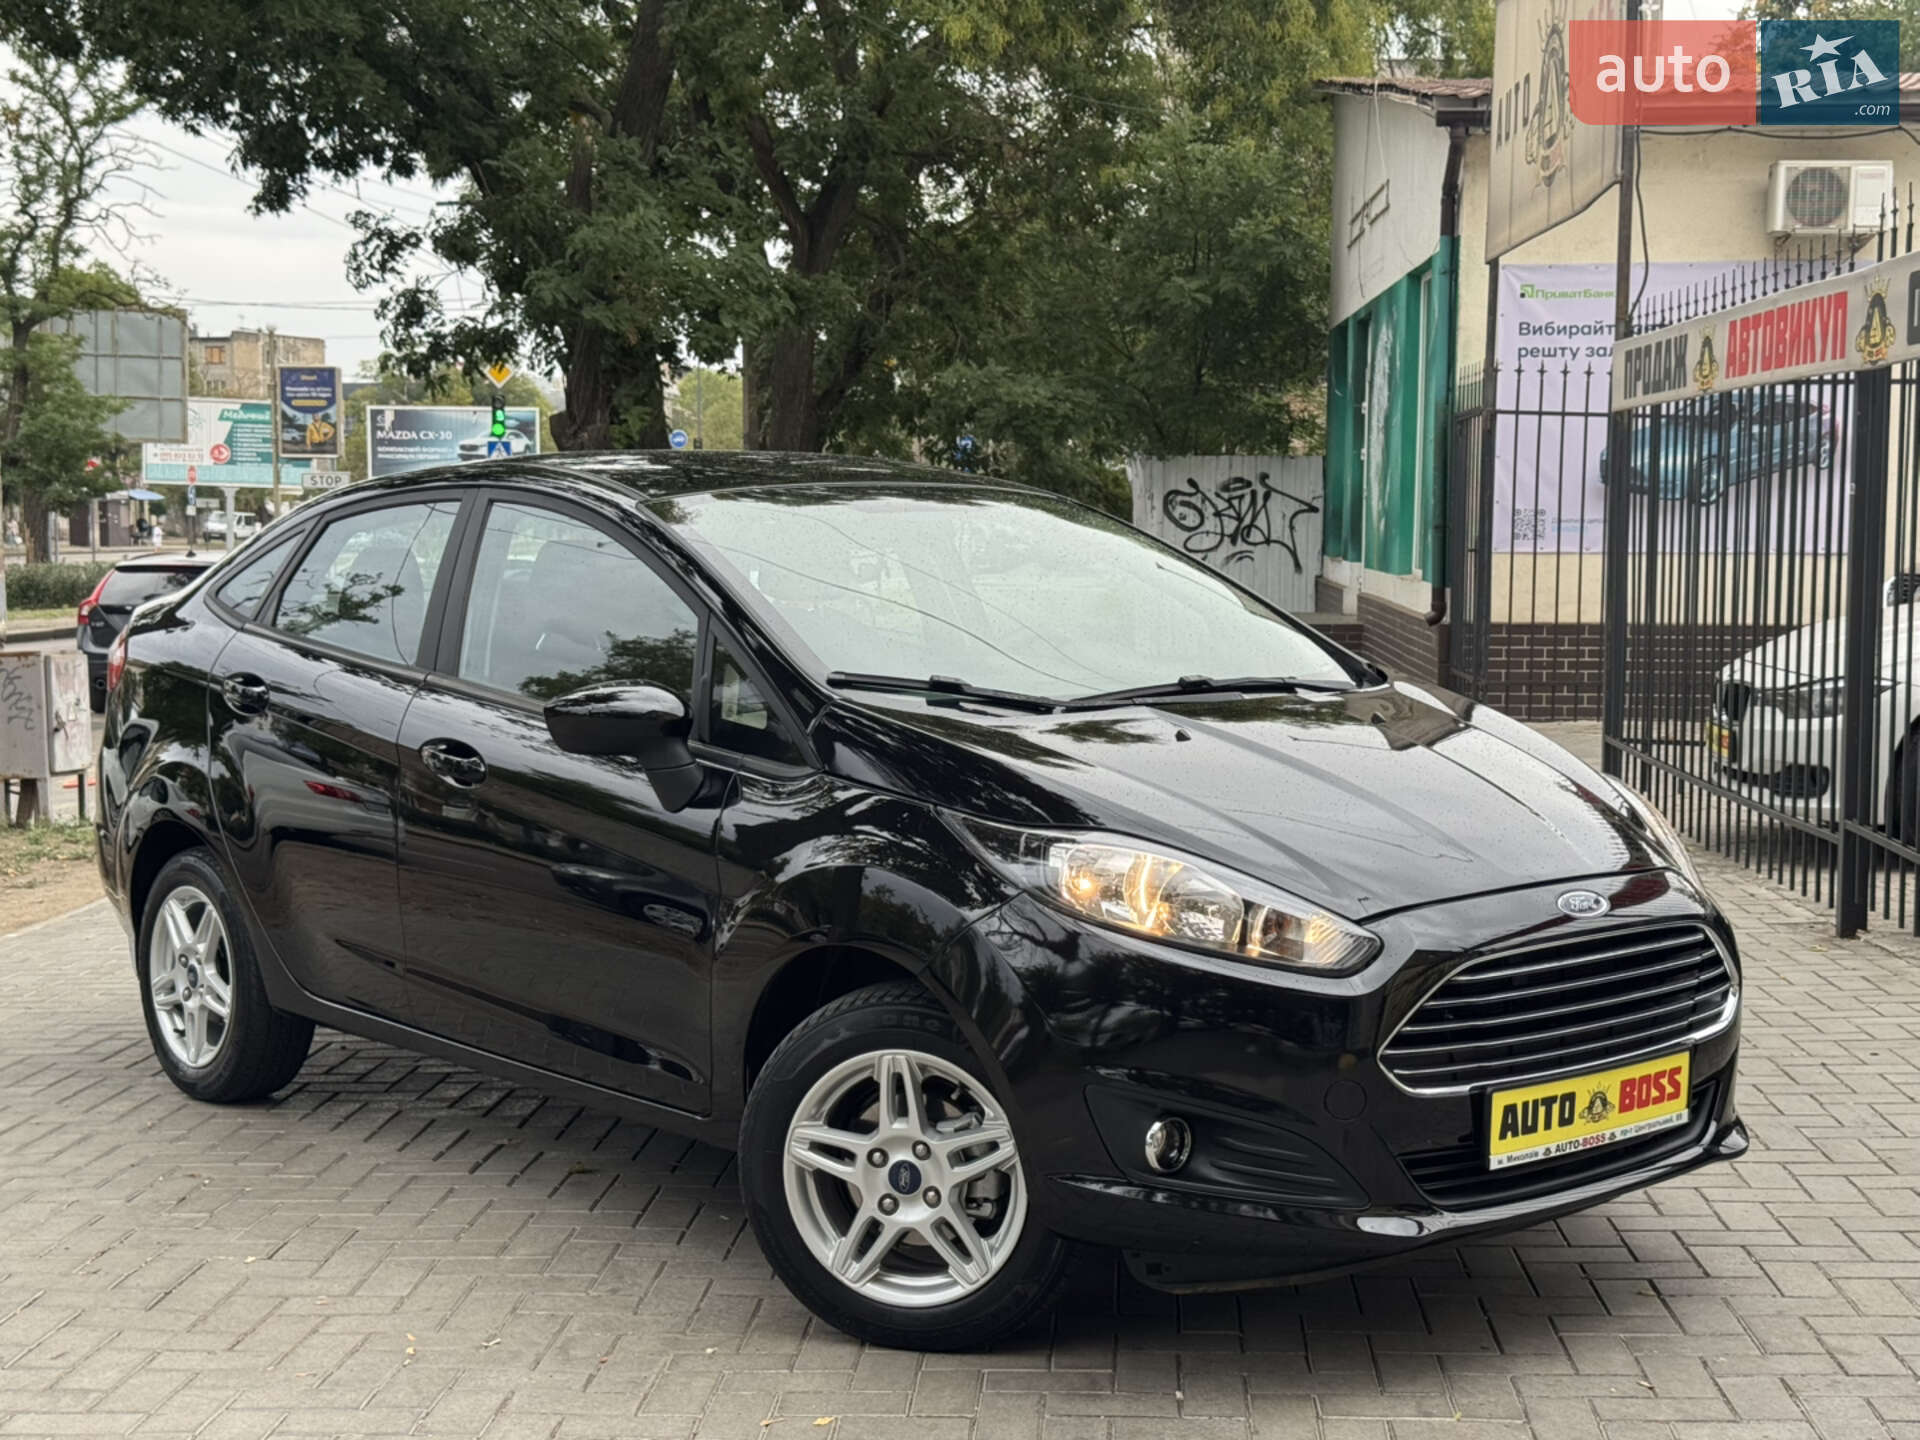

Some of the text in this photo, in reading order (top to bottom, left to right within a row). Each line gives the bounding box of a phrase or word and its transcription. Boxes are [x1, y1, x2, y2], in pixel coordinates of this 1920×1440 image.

[1518, 320, 1616, 339] Вибирайт
[1518, 346, 1580, 361] решту
[1624, 333, 1688, 400] ПРОДАЖ
[1725, 291, 1848, 379] АВТОВИКУП
[376, 430, 417, 440] MAZDA
[310, 475, 342, 486] STOP
[1498, 1065, 1682, 1141] AUTO BOSS
[1554, 1132, 1606, 1155] AUTO-BOSS
